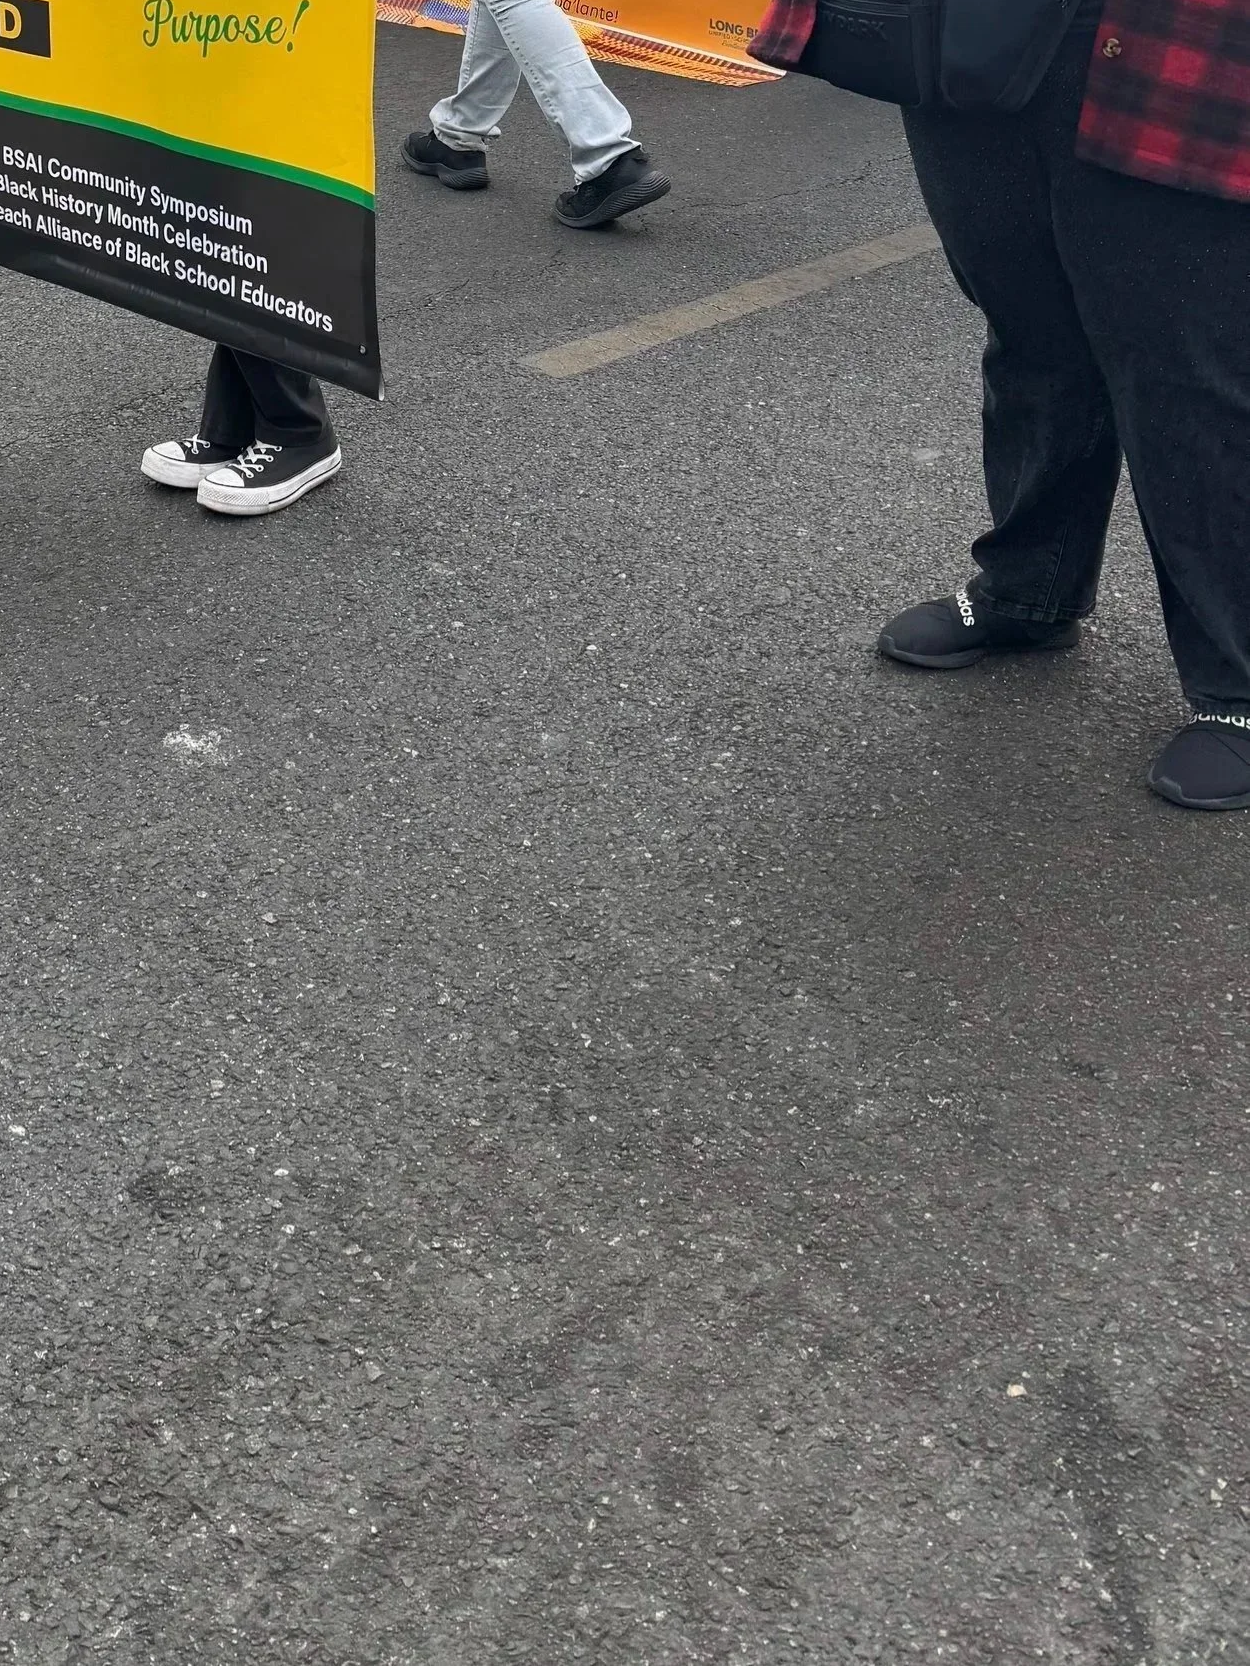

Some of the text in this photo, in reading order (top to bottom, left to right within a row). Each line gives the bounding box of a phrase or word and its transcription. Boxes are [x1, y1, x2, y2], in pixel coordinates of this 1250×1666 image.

[709, 17, 744, 36] LONG
[2, 145, 254, 236] BSAI Community Symposium
[41, 186, 104, 225] History
[107, 203, 160, 239] Month
[163, 222, 268, 274] Celebration
[35, 214, 103, 251] Alliance
[105, 237, 122, 258] of
[125, 240, 171, 276] Black
[174, 258, 236, 298] School
[240, 278, 334, 333] Educators
